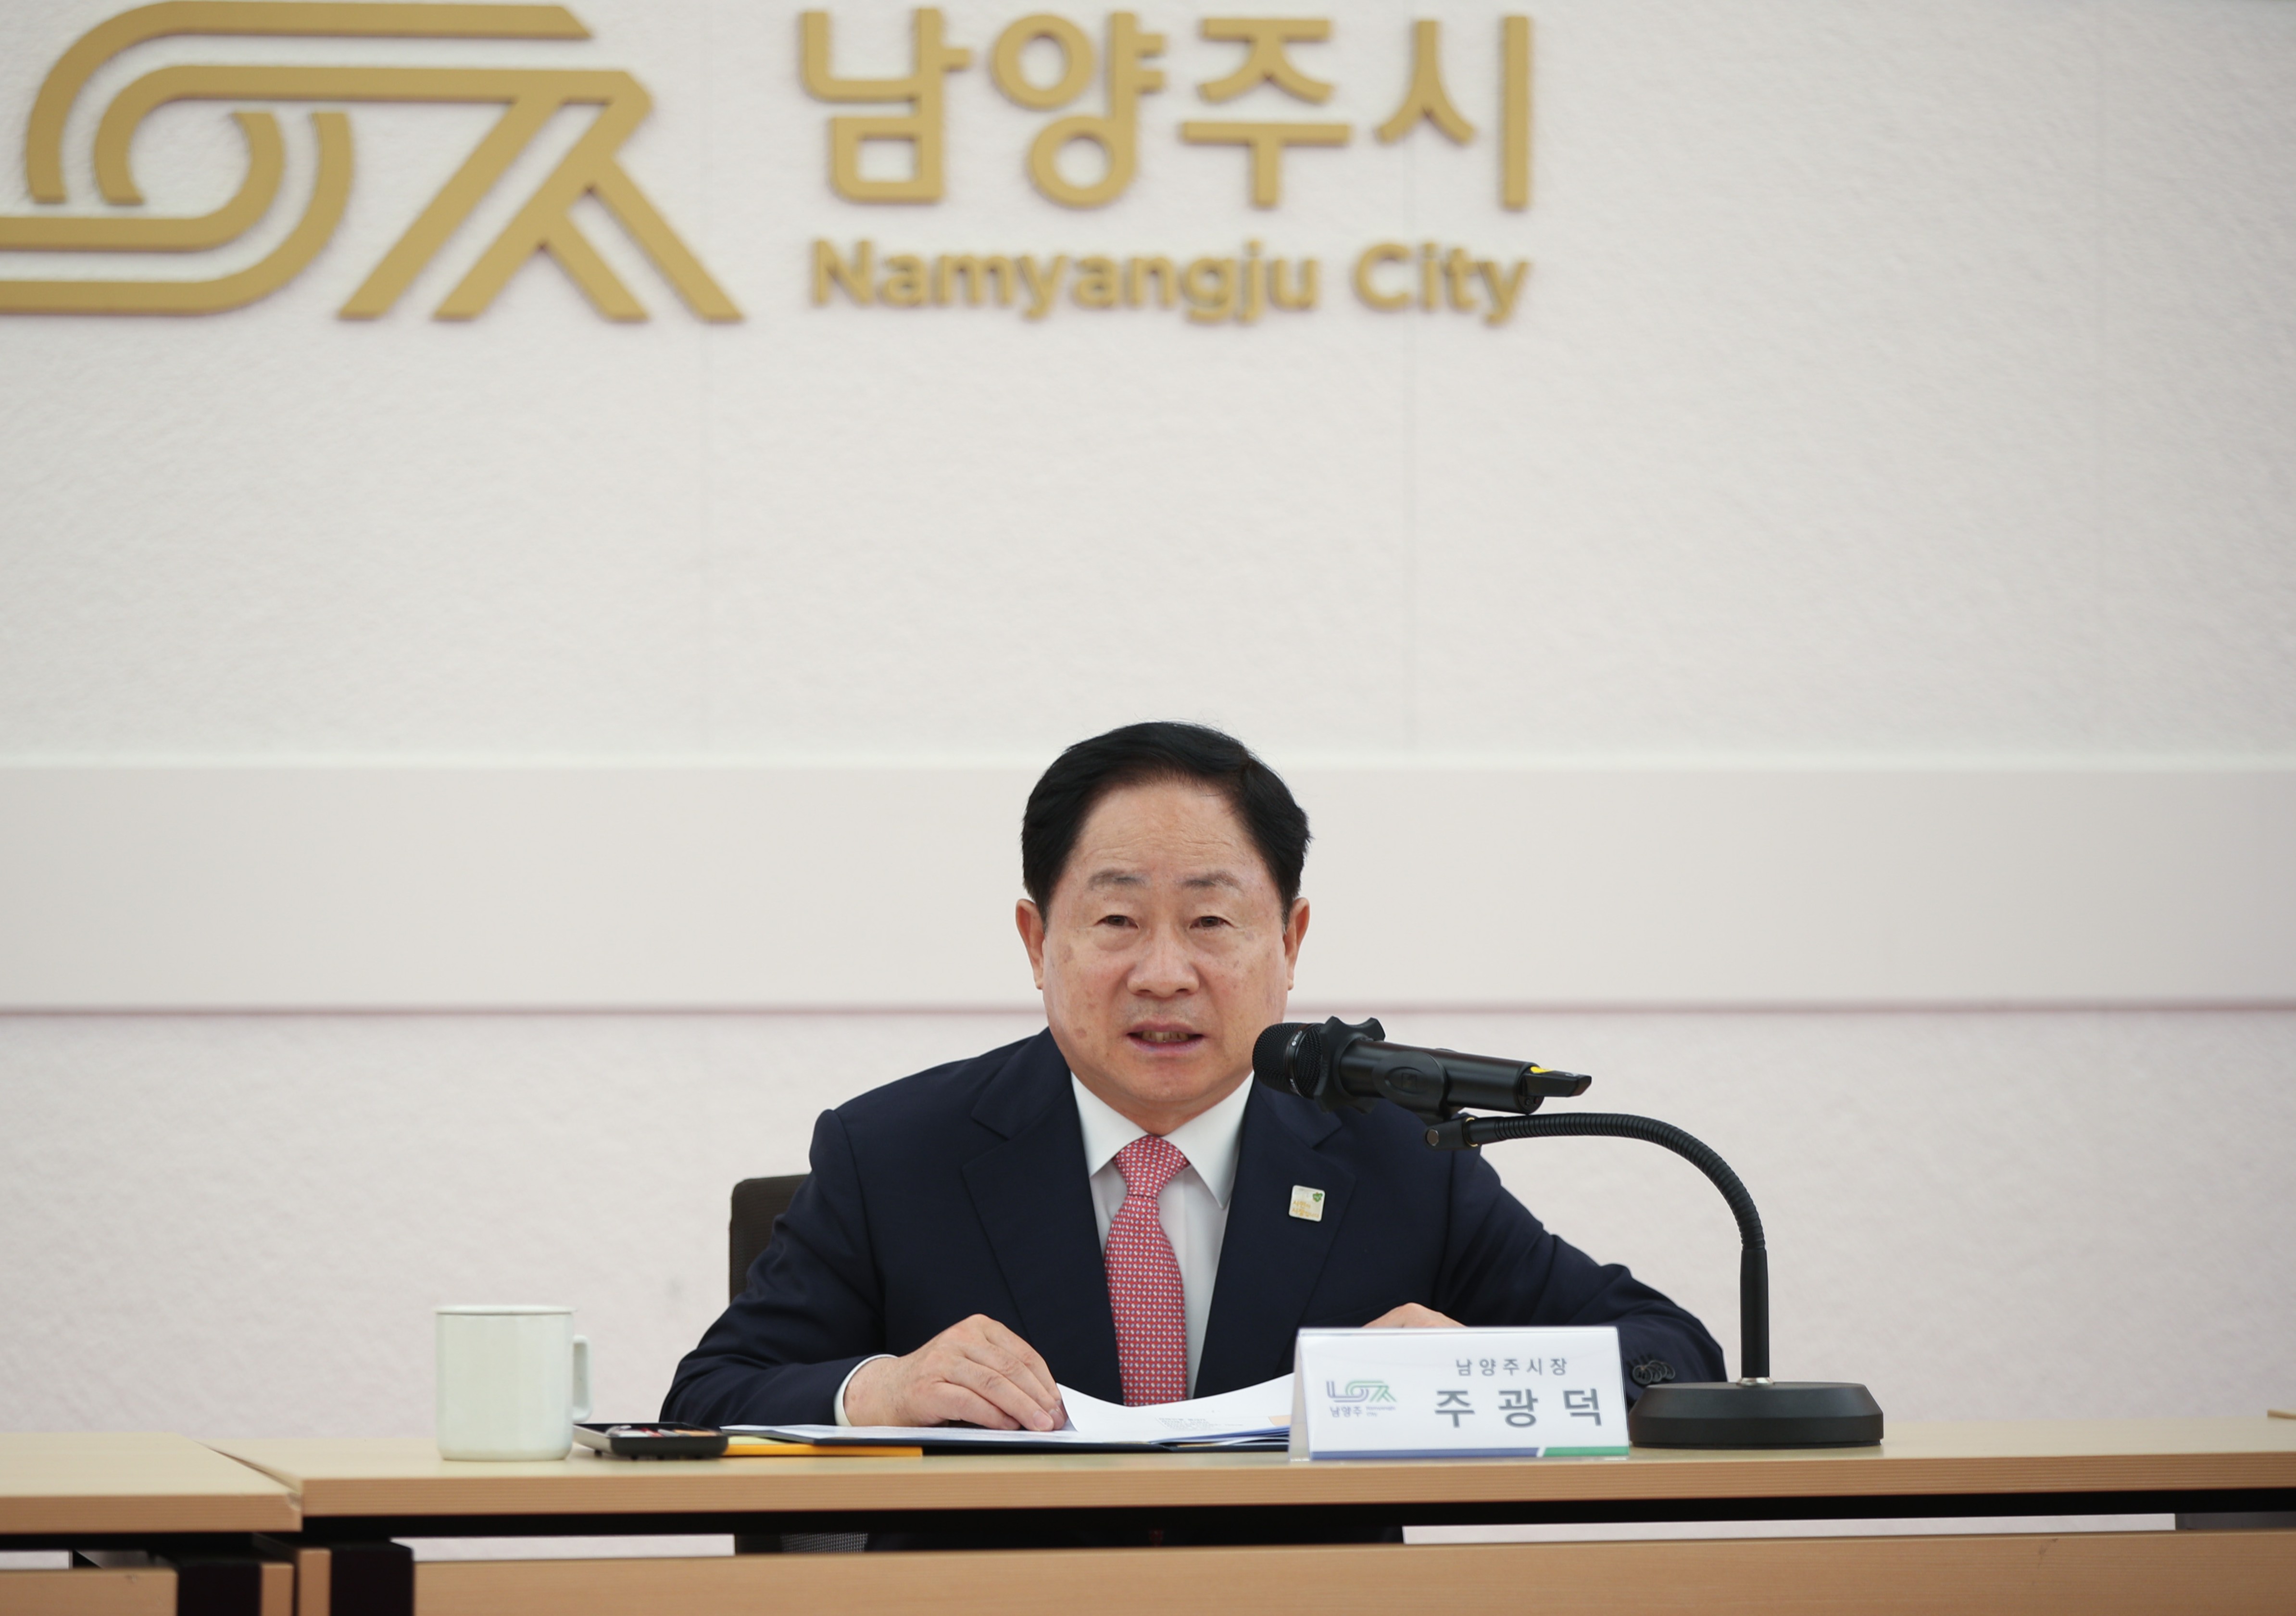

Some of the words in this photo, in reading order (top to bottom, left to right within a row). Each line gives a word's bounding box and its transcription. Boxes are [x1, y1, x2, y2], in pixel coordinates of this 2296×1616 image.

[800, 7, 1533, 210] 남양주시
[813, 239, 1319, 323] Namyangju
[1354, 241, 1531, 325] City
[1456, 1358, 1568, 1377] 남양주시장
[1330, 1406, 1362, 1417] 남양주
